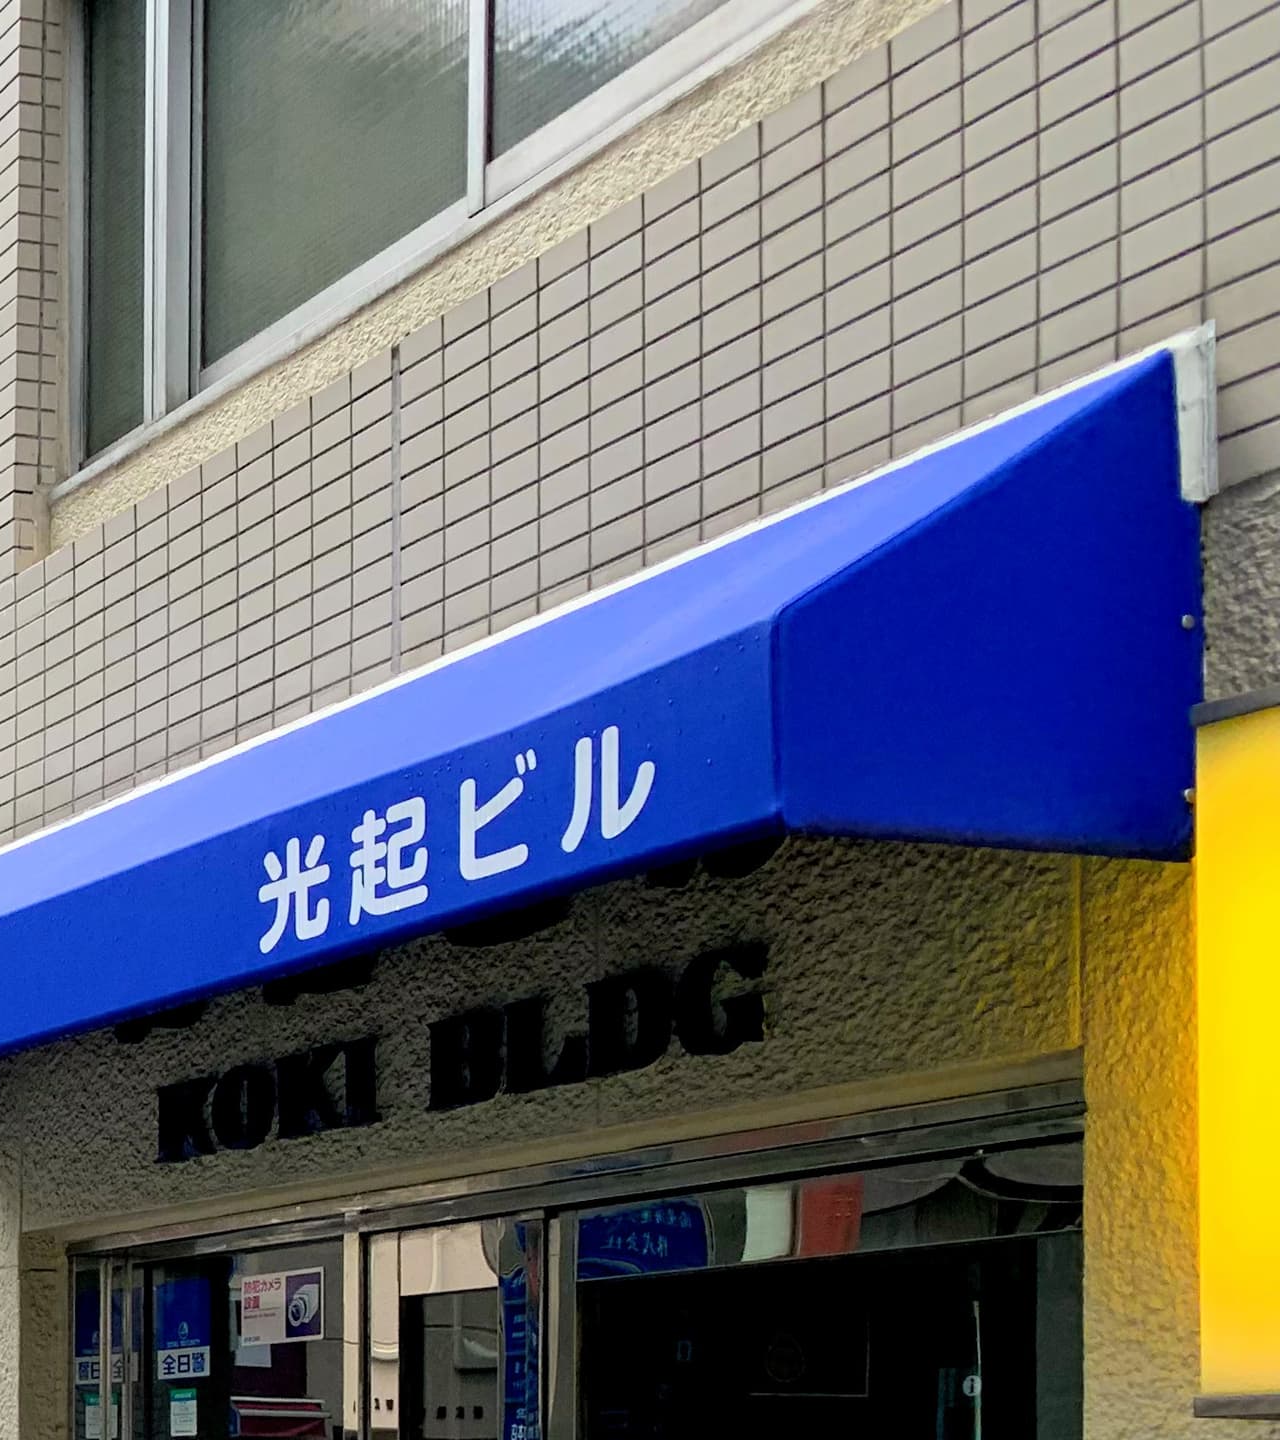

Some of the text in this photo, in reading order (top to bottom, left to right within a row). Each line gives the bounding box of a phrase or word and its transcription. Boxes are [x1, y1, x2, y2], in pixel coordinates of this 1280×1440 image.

[258, 724, 657, 954] 光起ビル
[154, 939, 773, 1165] KOKI BLDG
[162, 1351, 206, 1376] 全日警
